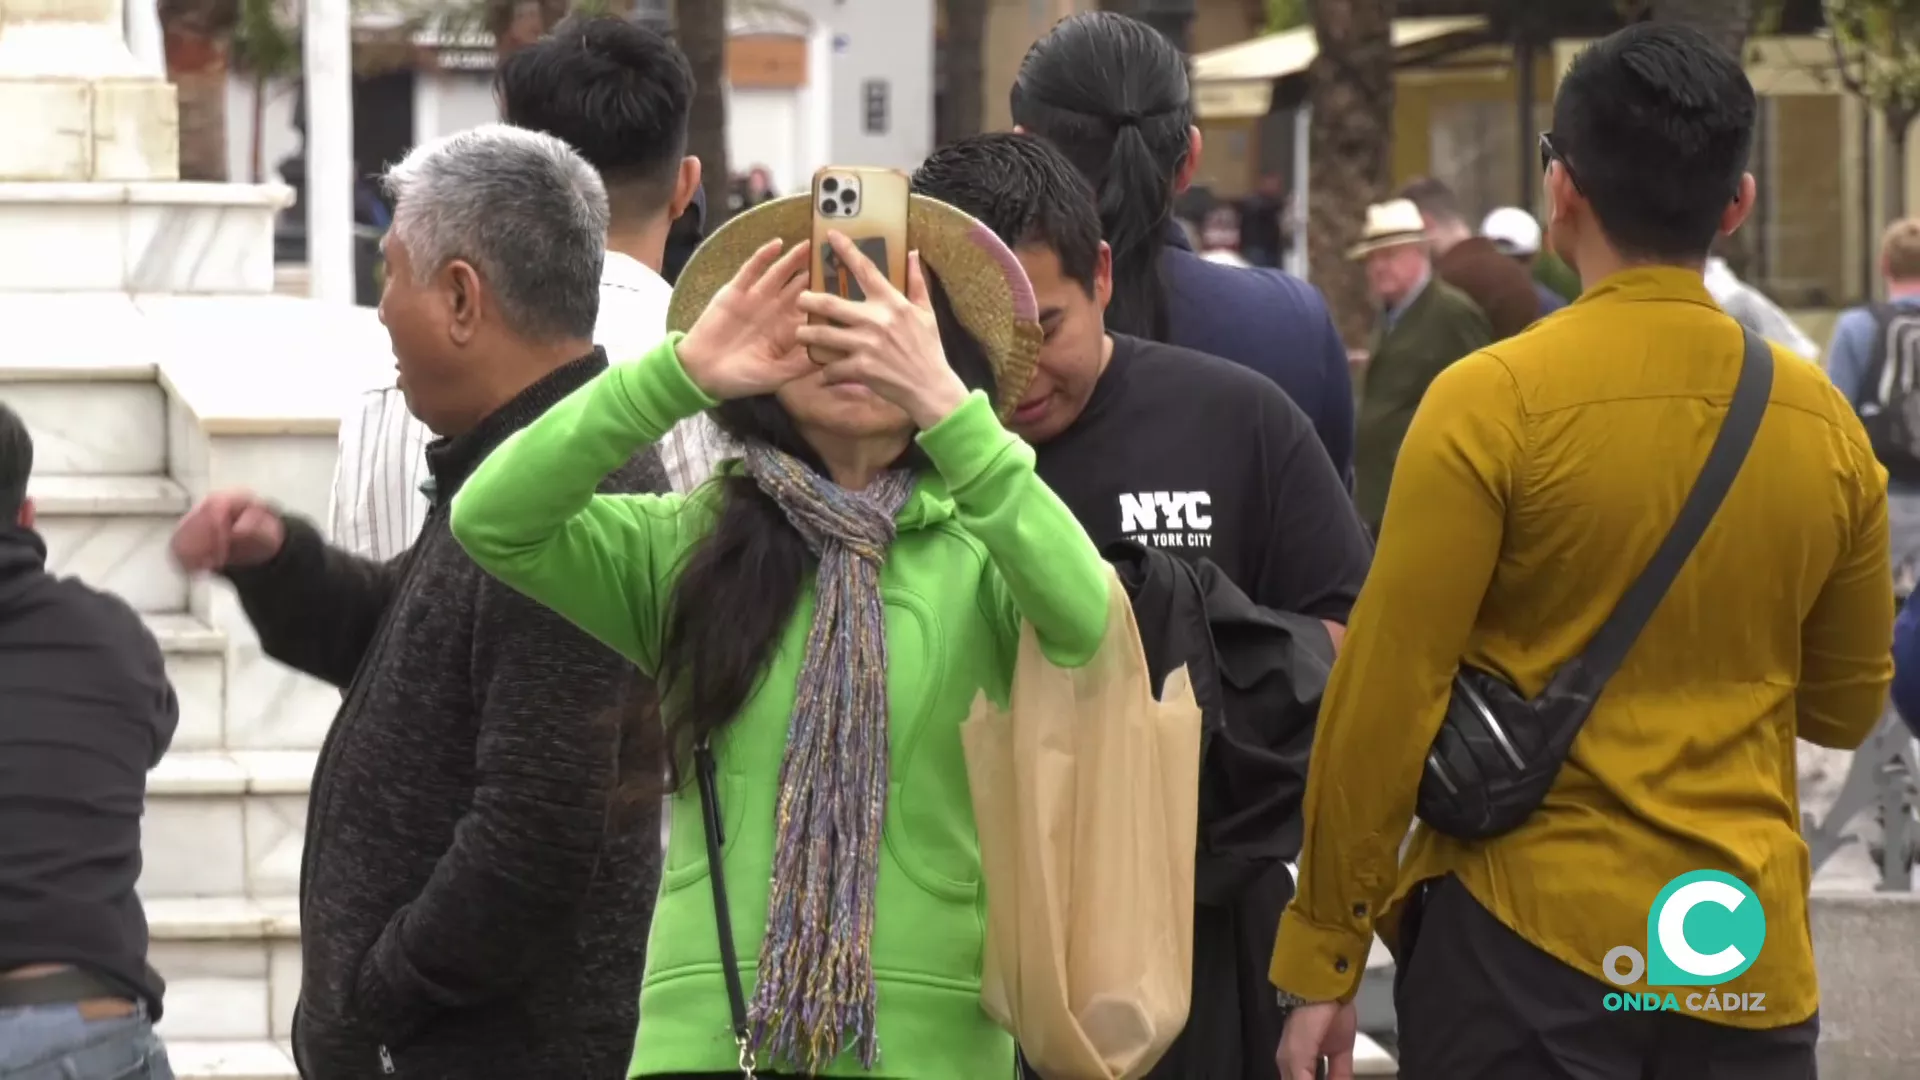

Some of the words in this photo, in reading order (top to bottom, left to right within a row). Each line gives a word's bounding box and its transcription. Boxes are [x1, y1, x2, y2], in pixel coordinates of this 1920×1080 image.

[1119, 491, 1212, 532] NYC
[1152, 533, 1184, 547] YORK
[1187, 533, 1212, 547] CITY
